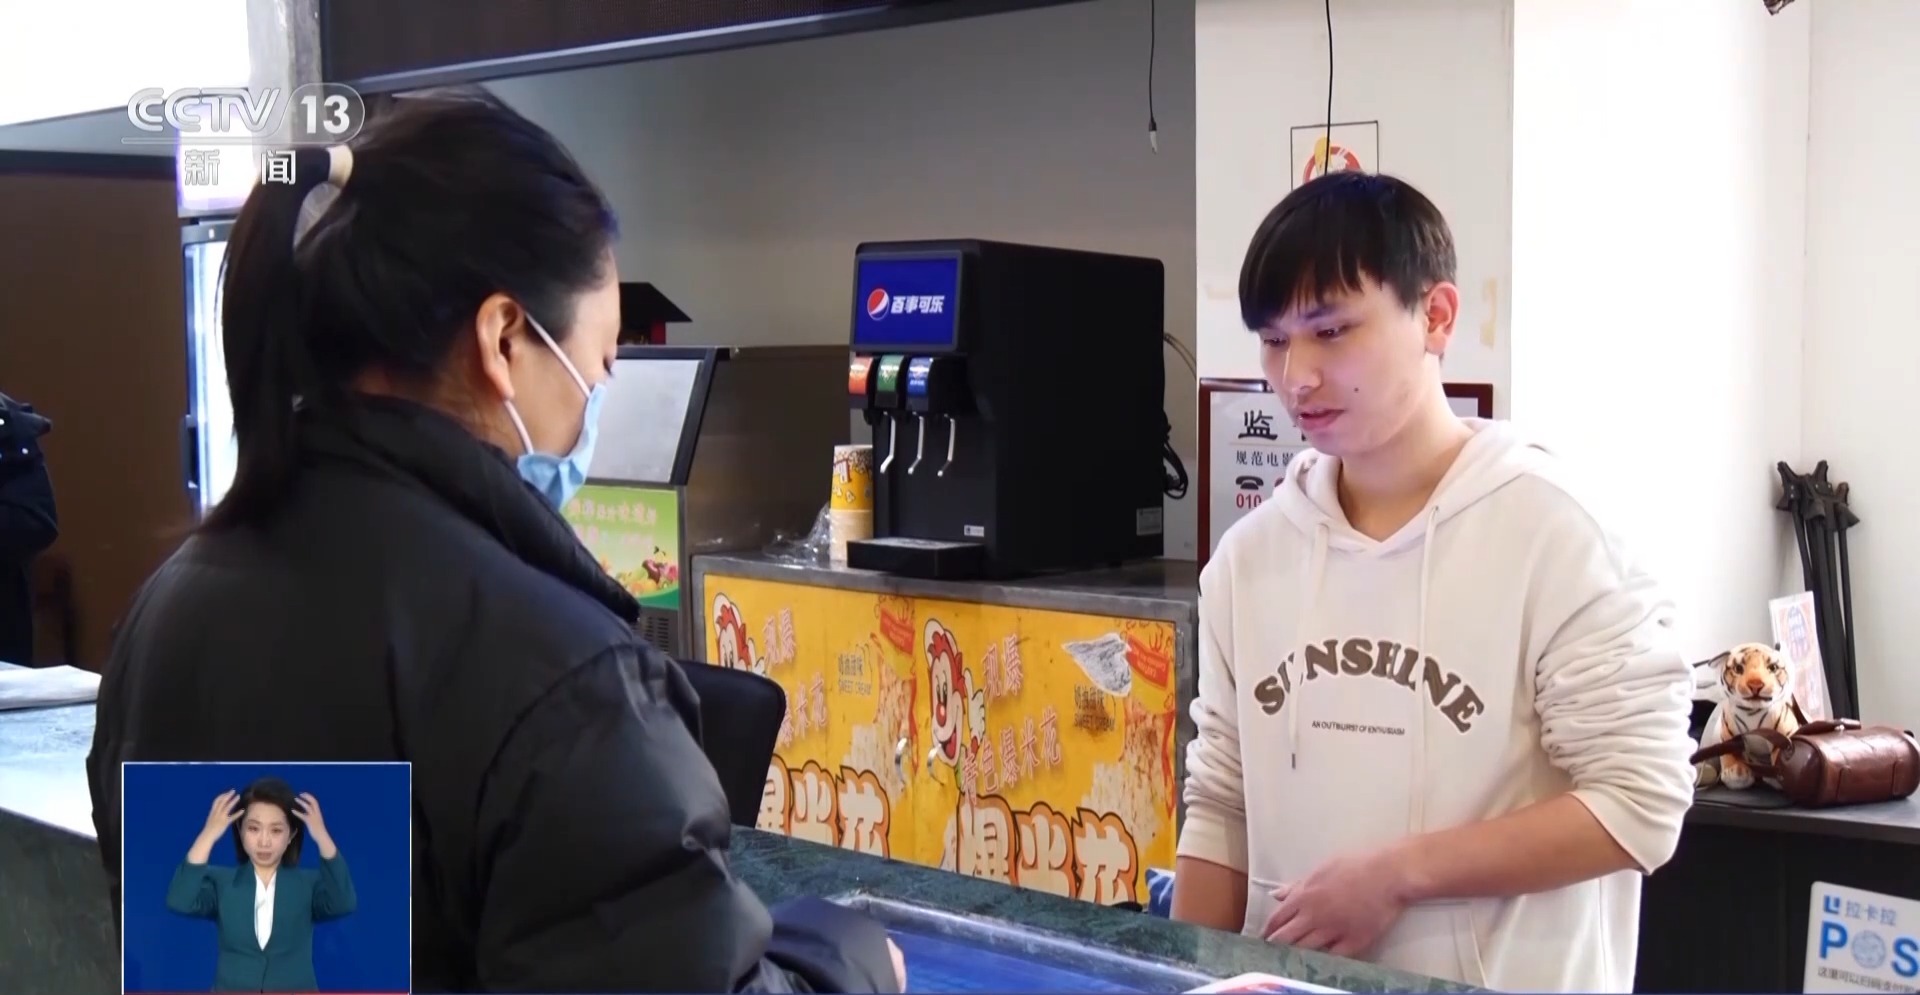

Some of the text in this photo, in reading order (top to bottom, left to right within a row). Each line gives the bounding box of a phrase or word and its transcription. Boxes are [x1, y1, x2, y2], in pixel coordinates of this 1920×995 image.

[891, 295, 945, 314] 百事可乐
[1236, 493, 1262, 509] 010
[763, 607, 796, 668] 现爆
[983, 634, 1023, 699] 现爆
[1254, 638, 1485, 733] SNSHINE
[963, 706, 1062, 807] 特色爆米花
[1359, 725, 1367, 733] OF
[1845, 899, 1897, 926] 拉卡拉
[1819, 920, 1919, 978] POS
